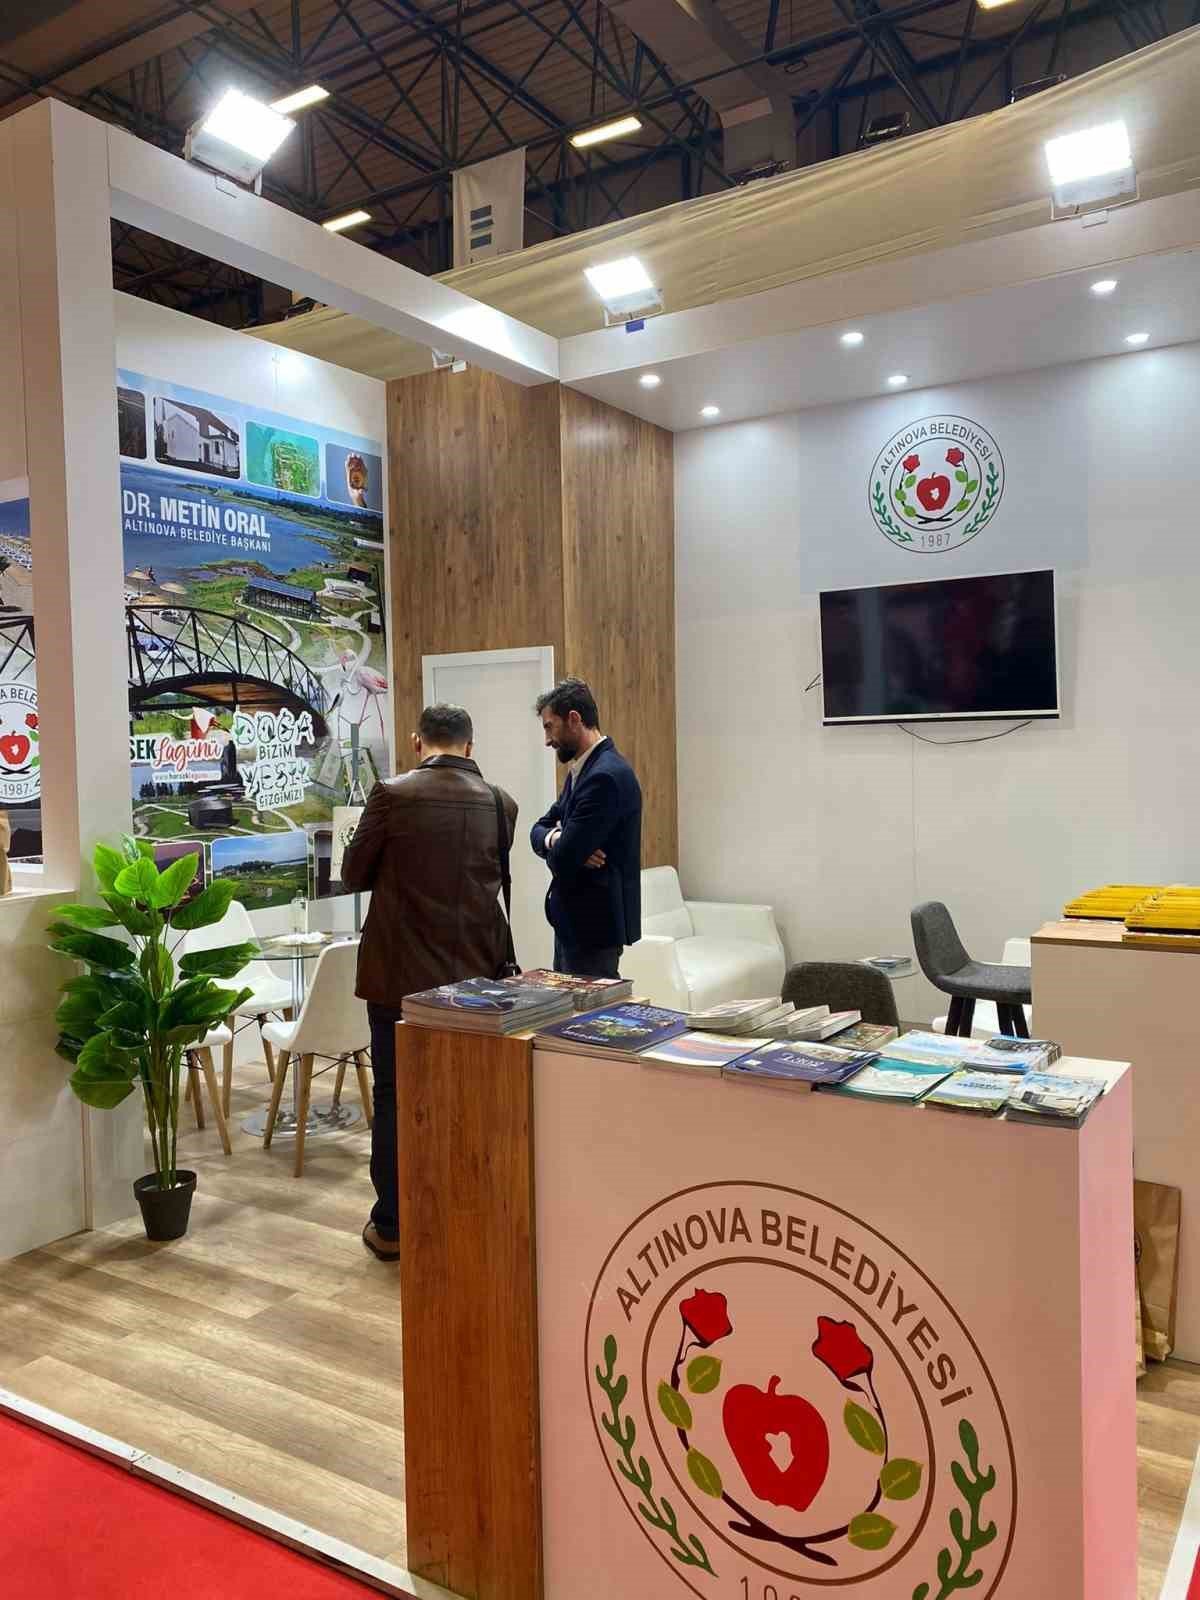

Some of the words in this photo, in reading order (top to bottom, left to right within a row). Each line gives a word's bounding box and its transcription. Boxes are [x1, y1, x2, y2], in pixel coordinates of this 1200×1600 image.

[880, 426, 928, 476] ALTINOVA
[930, 422, 993, 461] BELEDİYESİ
[122, 490, 155, 519] DR.
[160, 496, 220, 530] METİN
[224, 508, 271, 538] ORAL
[124, 518, 176, 538] ALTINOVA
[180, 527, 227, 545] BELEDİYE
[231, 535, 271, 553] BAŞKANI
[920, 533, 951, 548] 1987
[10, 687, 39, 706] BELE
[259, 743, 293, 760] BİZİM
[614, 1206, 753, 1322] ALTINOVA
[760, 1208, 974, 1408] BELEDİYESİ
